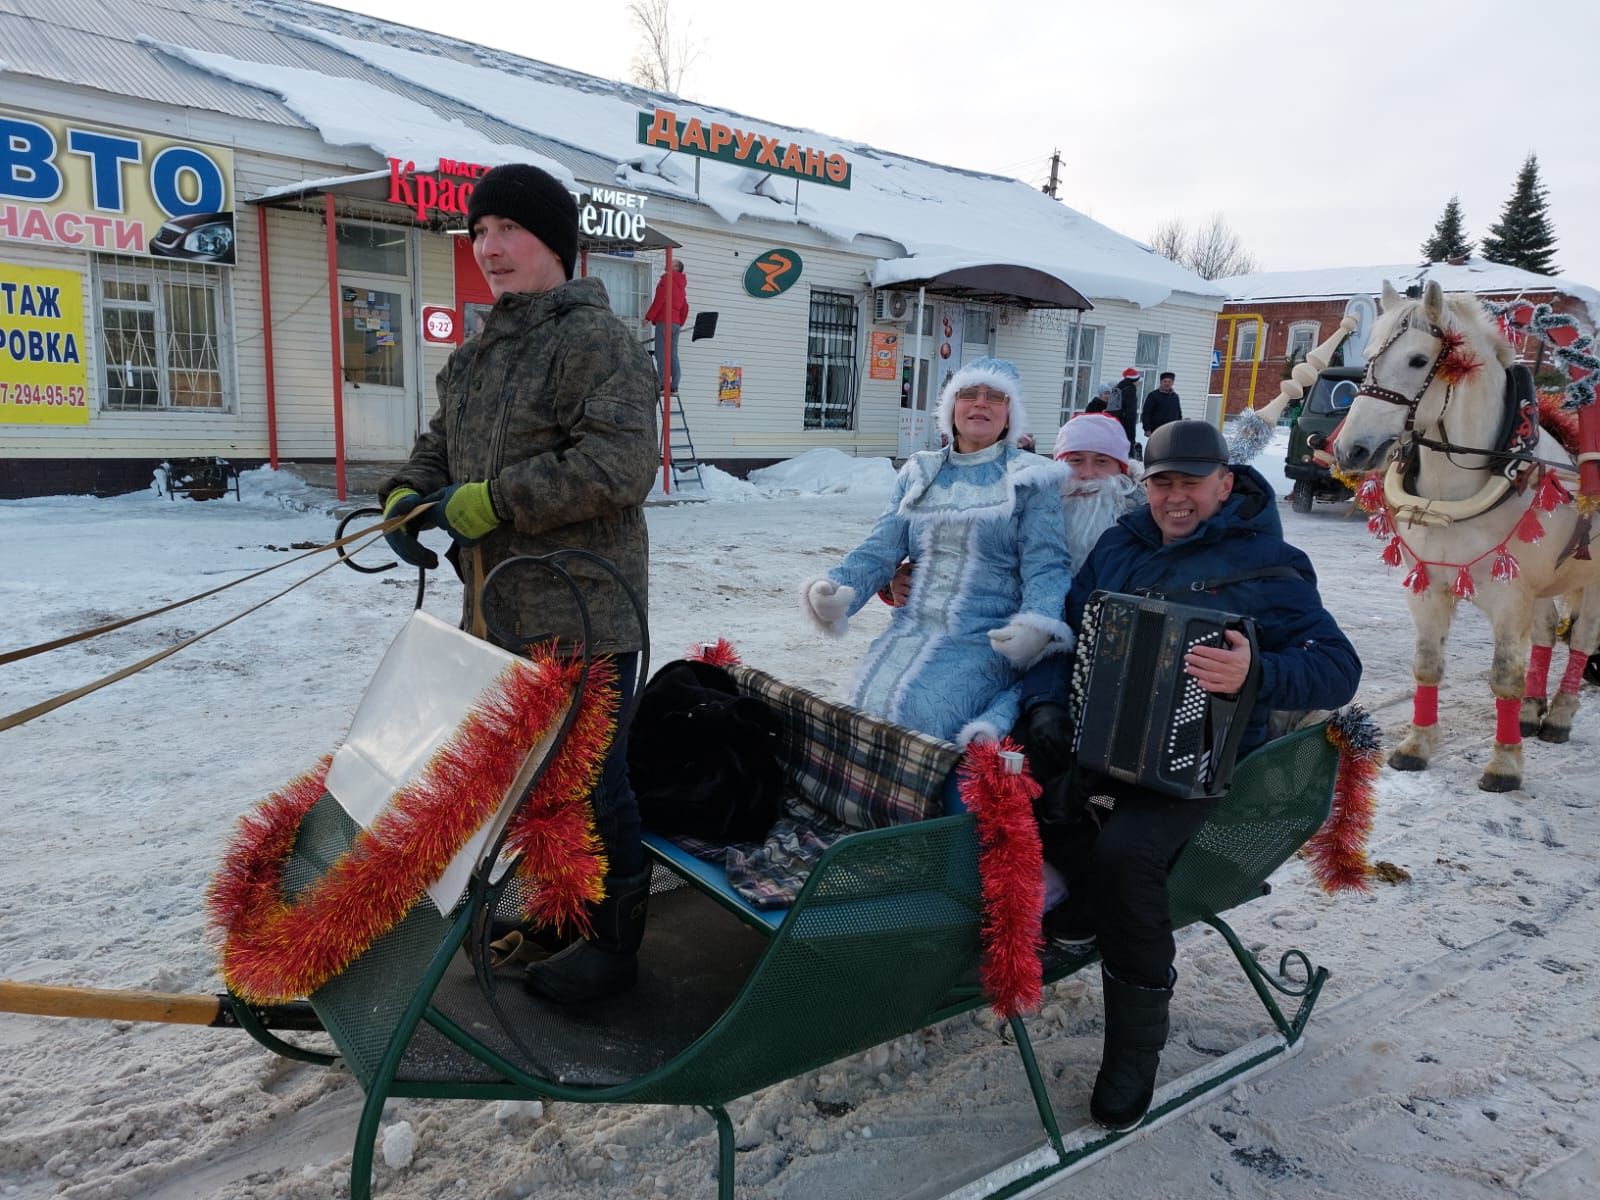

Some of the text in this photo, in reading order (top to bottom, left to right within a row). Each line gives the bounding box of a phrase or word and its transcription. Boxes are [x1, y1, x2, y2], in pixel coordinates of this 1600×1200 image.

[646, 108, 848, 183] ДАРУХАНӘ
[0, 116, 226, 220] ВТО
[591, 186, 648, 209] КИБЕТ
[578, 203, 646, 243] елое
[0, 282, 61, 319] ТАЖ
